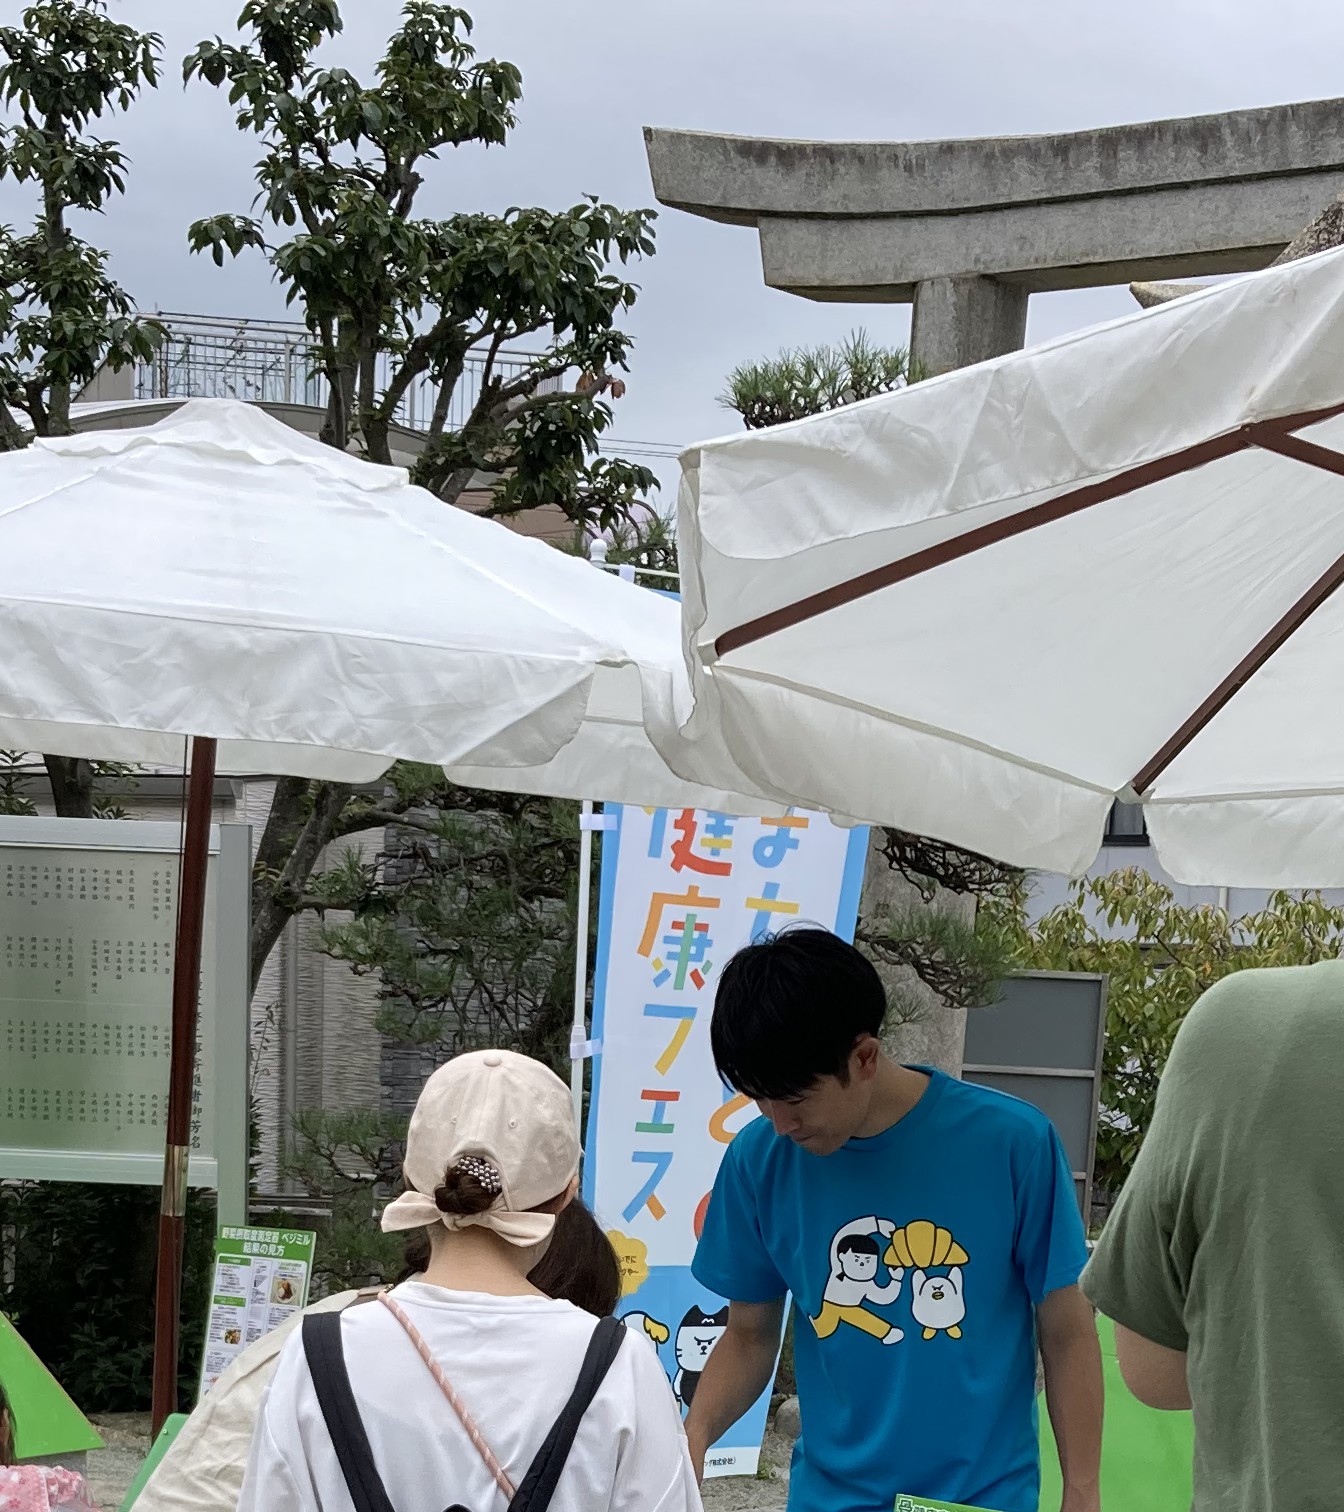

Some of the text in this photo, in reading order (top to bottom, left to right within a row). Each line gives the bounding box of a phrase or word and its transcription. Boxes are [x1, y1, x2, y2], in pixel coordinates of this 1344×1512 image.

[242, 1242, 286, 1257] 結果の見方
